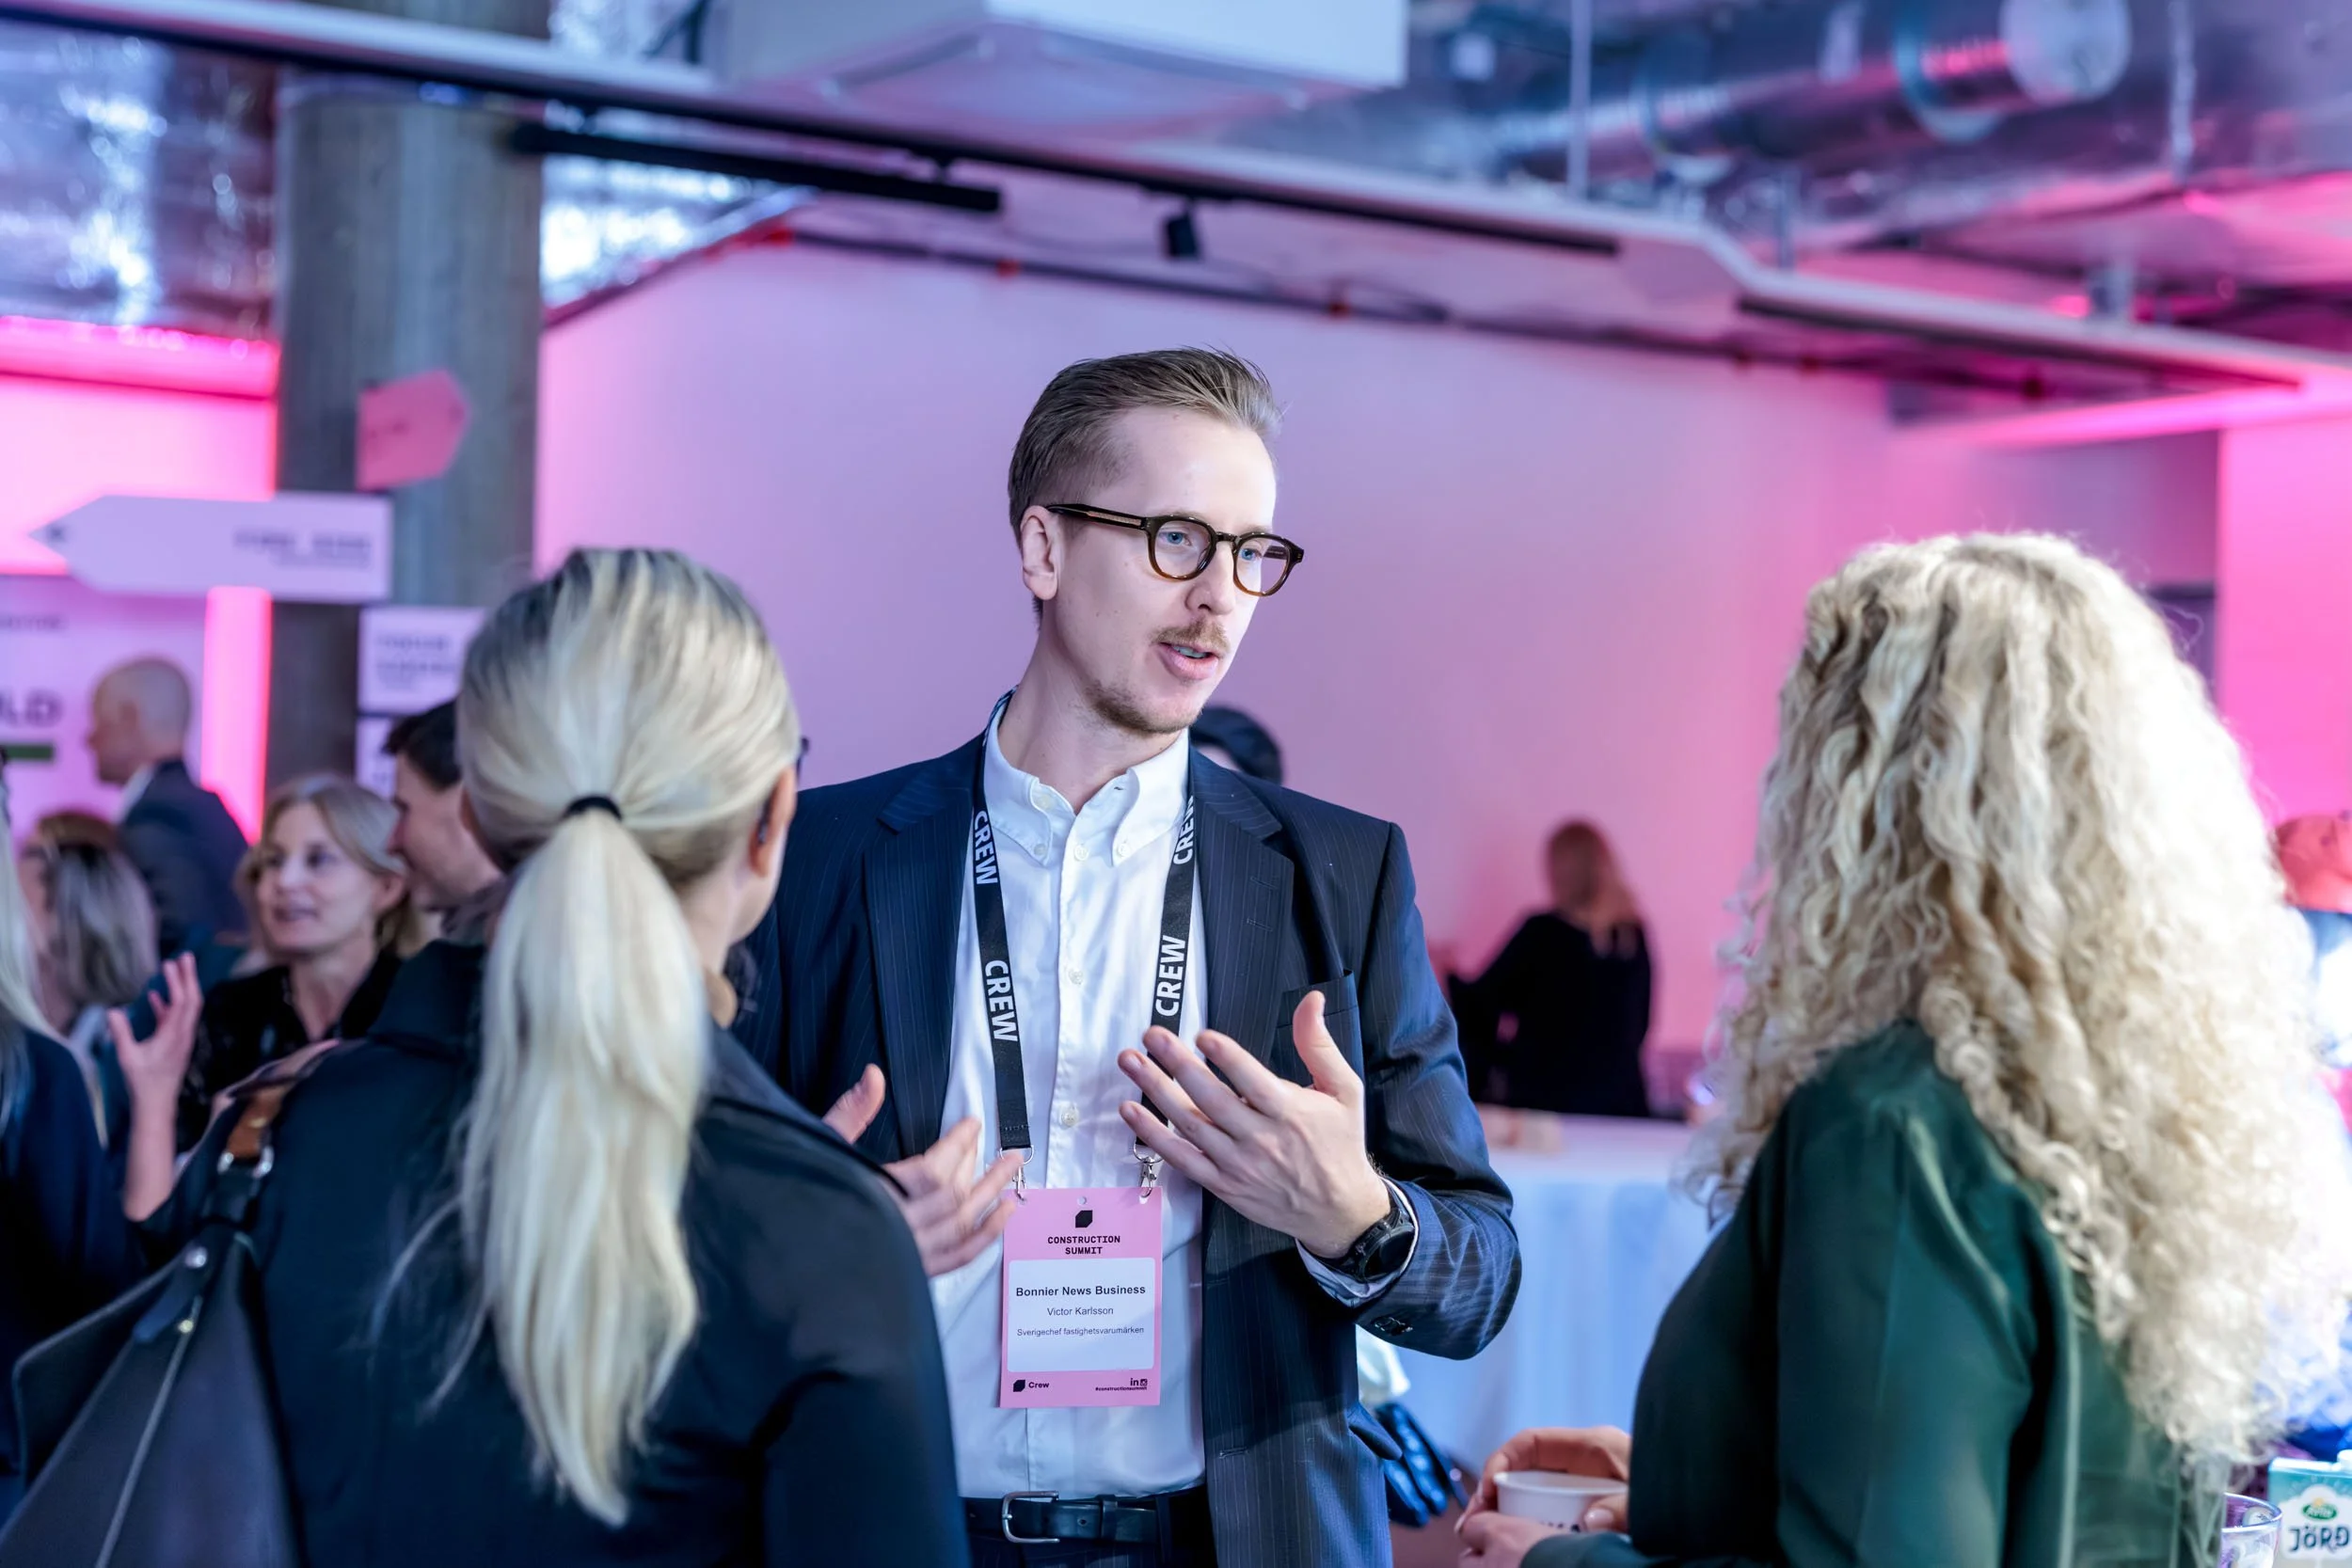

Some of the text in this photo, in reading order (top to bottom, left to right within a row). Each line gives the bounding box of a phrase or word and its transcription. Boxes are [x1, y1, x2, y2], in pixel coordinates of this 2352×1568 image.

[973, 810, 998, 885] CREW
[1172, 796, 1194, 864] CREW
[1155, 935, 1186, 1017] CREW
[985, 960, 1018, 1042] CREW
[1047, 1235, 1120, 1244] CONSTRUCTION
[1016, 1285, 1146, 1296] Bonnier News Business
[1047, 1307, 1113, 1316] Victor Karlsson
[1017, 1326, 1144, 1337] Sverigechef fastighetsvarumärken
